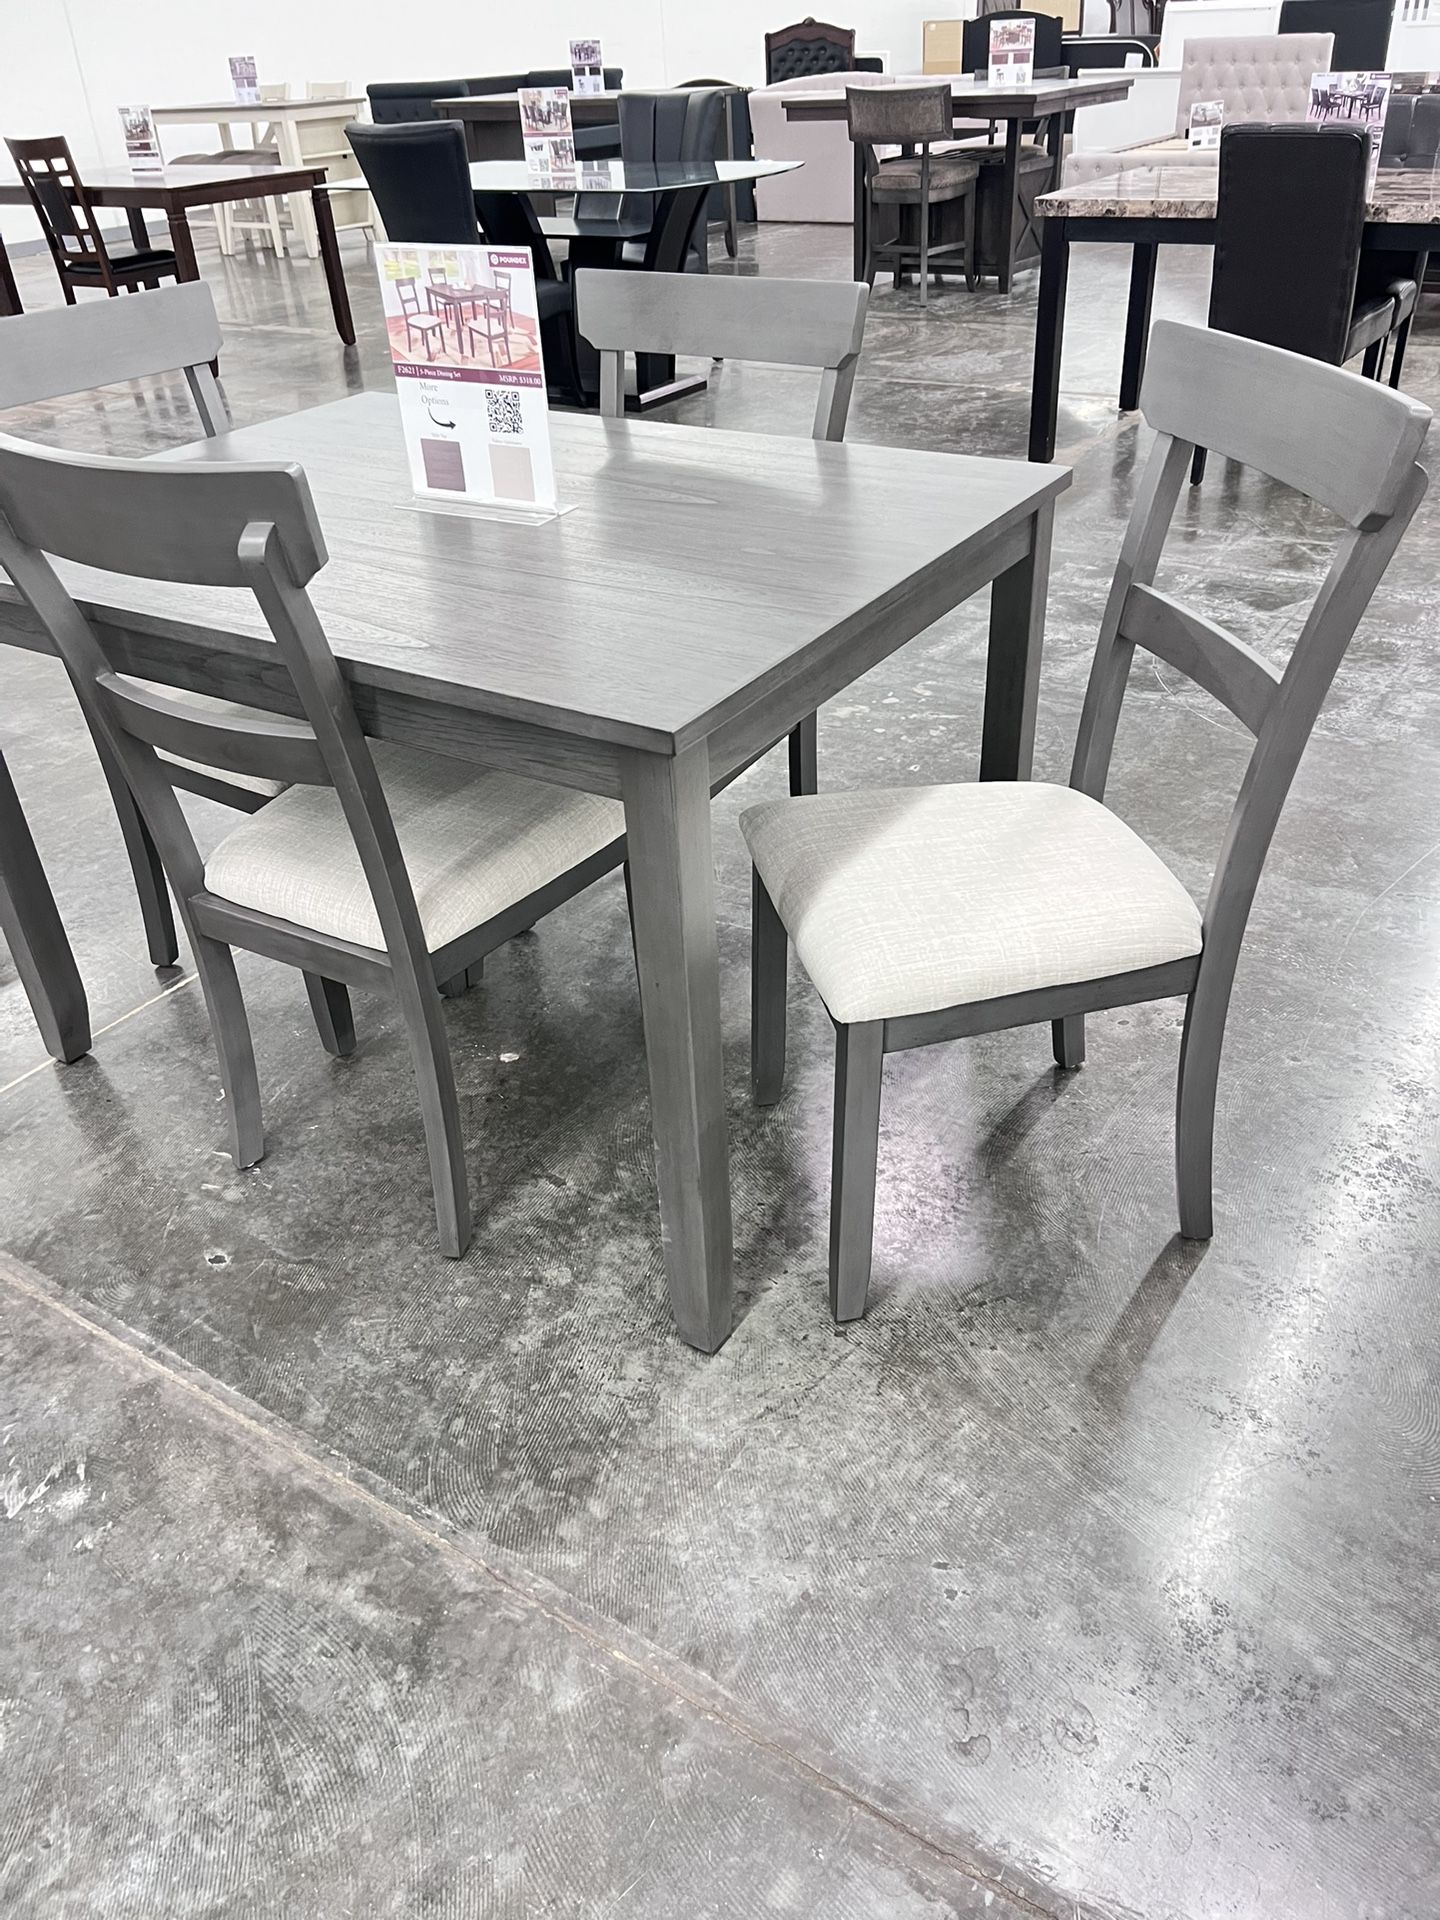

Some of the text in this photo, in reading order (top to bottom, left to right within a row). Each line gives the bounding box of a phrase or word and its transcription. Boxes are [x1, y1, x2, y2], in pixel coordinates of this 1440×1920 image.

[437, 369, 453, 379] Dining
[419, 382, 439, 392] More
[421, 395, 450, 407] Options
